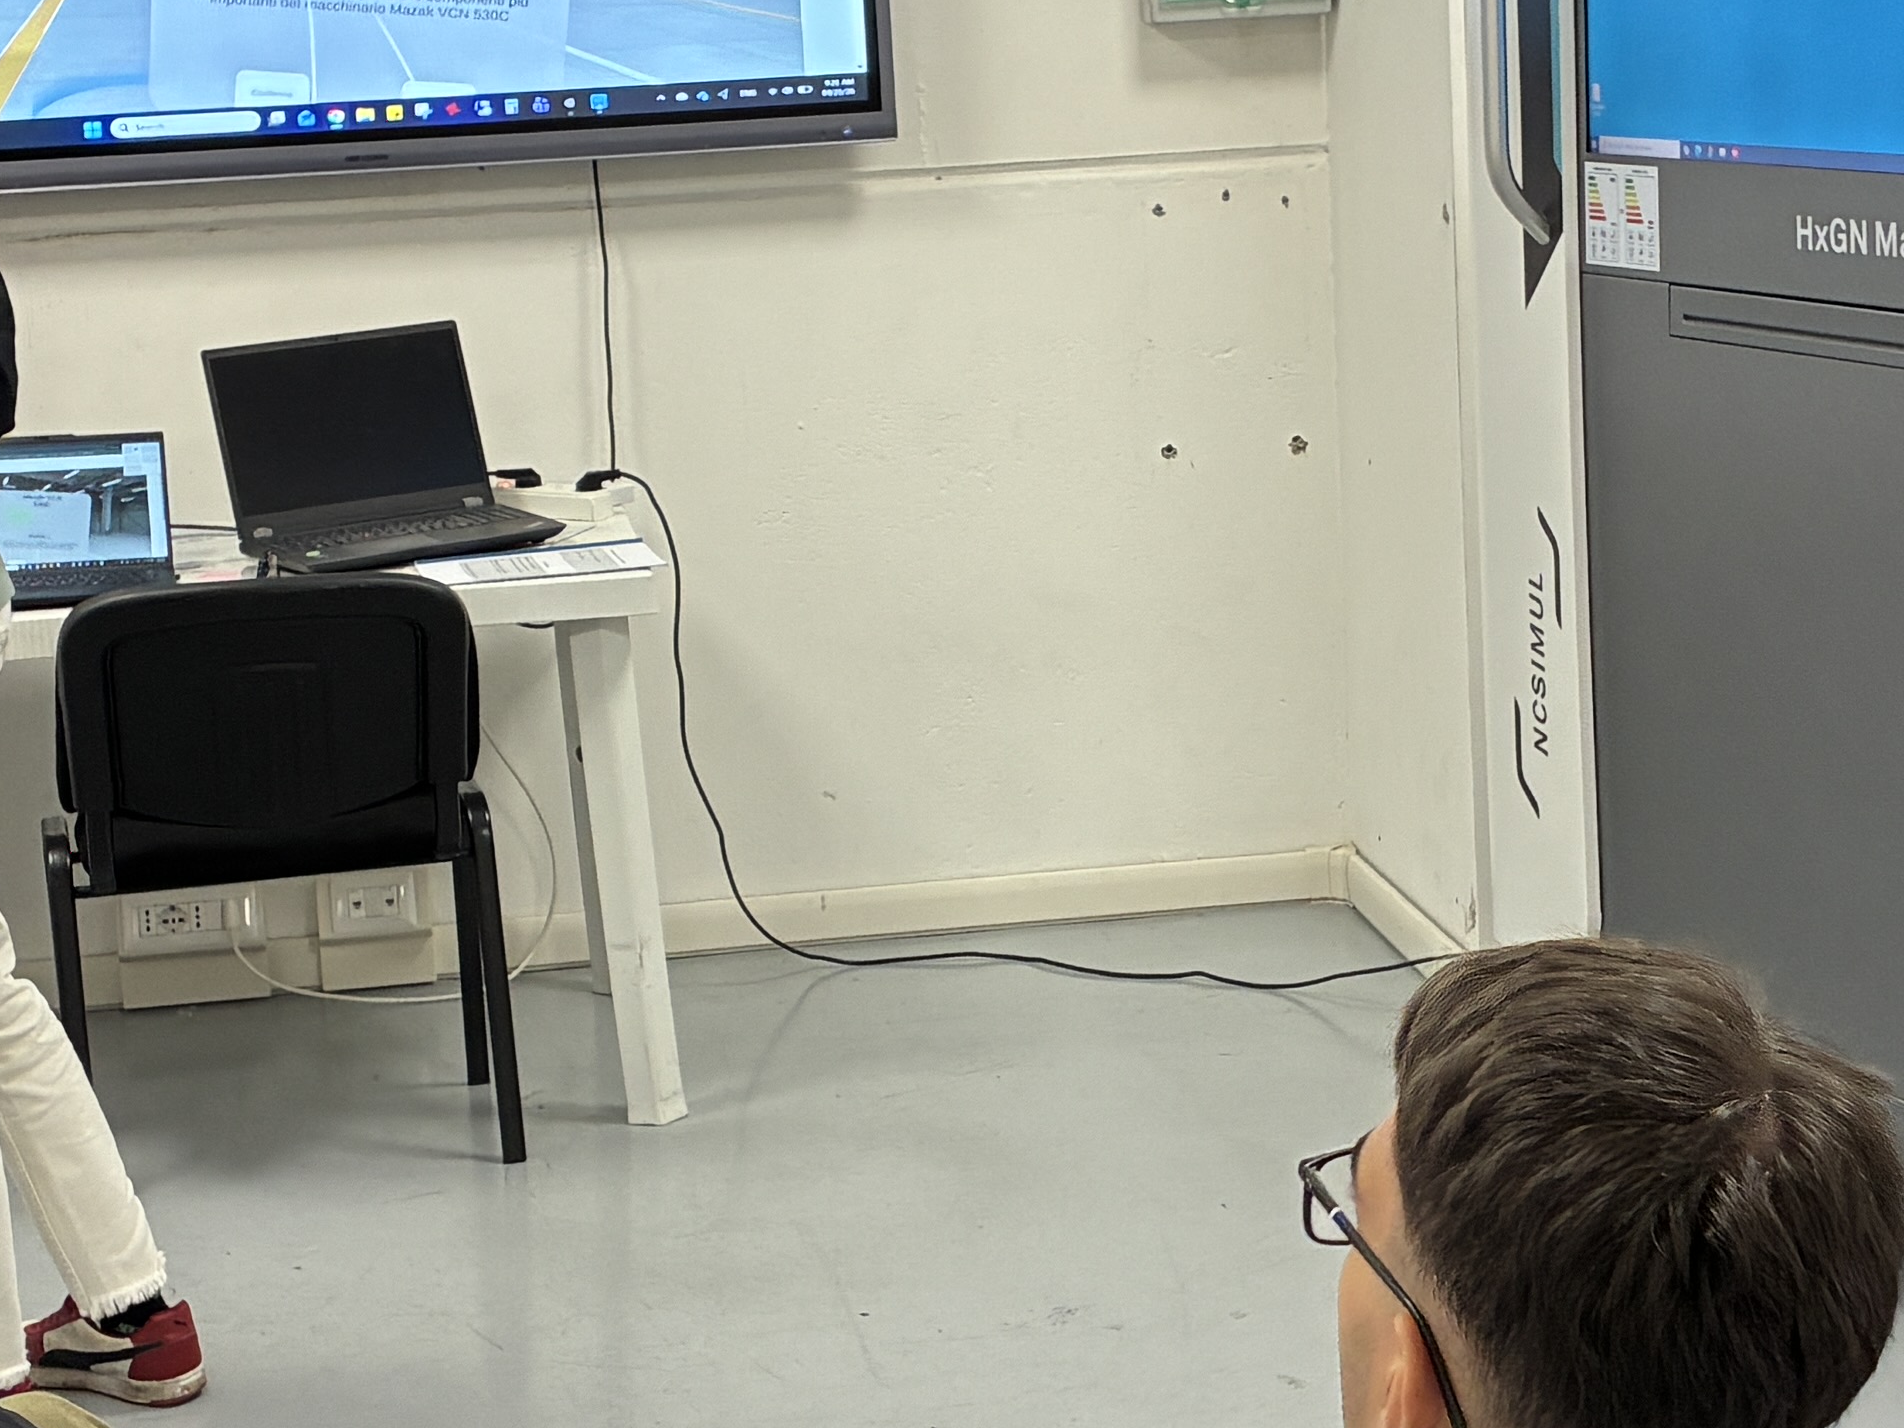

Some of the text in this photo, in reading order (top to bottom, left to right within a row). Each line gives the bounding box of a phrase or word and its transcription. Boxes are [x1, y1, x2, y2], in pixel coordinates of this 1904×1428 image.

[389, 3, 434, 18] Mazak
[437, 6, 470, 19] VCN
[473, 8, 510, 22] 530C
[1795, 214, 1869, 256] HxGN
[1528, 573, 1549, 757] NCSIMUL
